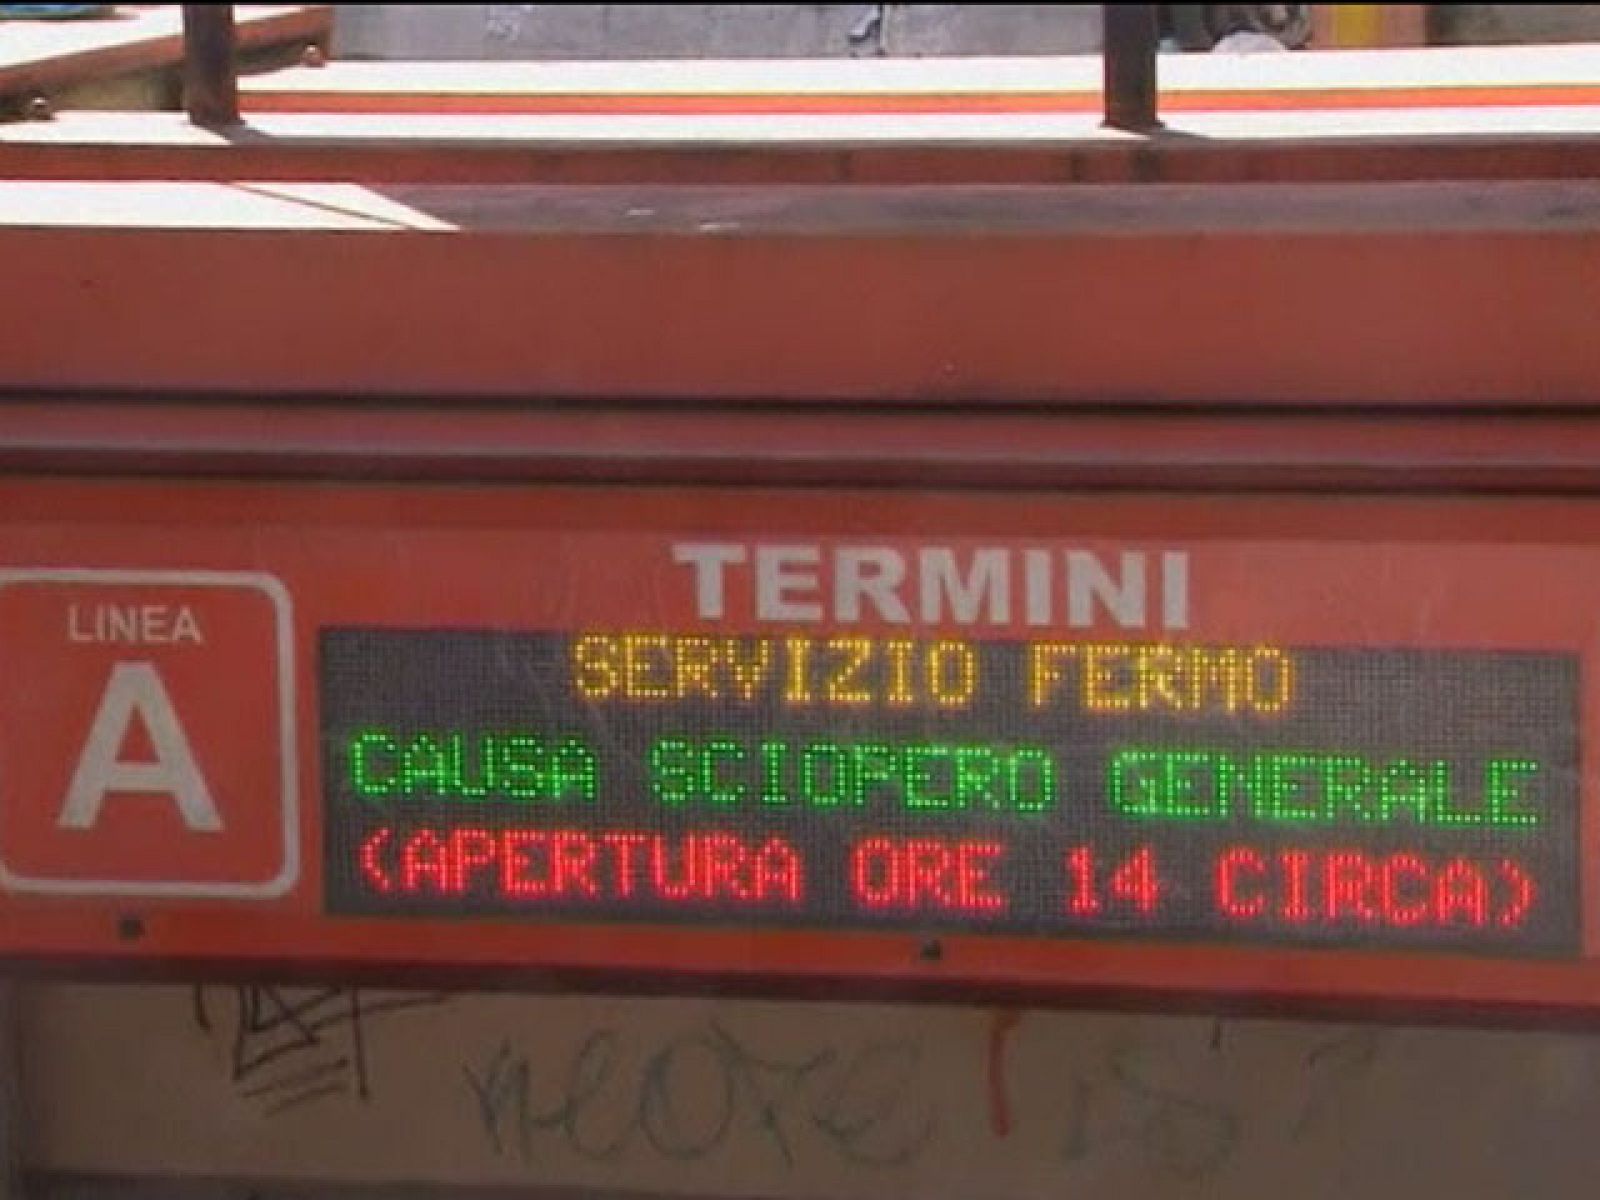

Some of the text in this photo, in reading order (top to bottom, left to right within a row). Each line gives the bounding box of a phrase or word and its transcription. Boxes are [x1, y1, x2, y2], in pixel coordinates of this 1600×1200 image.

[67, 603, 203, 643] LINEA
[673, 543, 1191, 629] TERMINI
[573, 634, 1294, 713] SERVIZIO FERMO
[56, 661, 225, 830] A
[350, 732, 1539, 827] CAUSA SCIOPERO GENERALE
[360, 827, 1535, 927] (APERTURA ORE 14 CIRCA)
